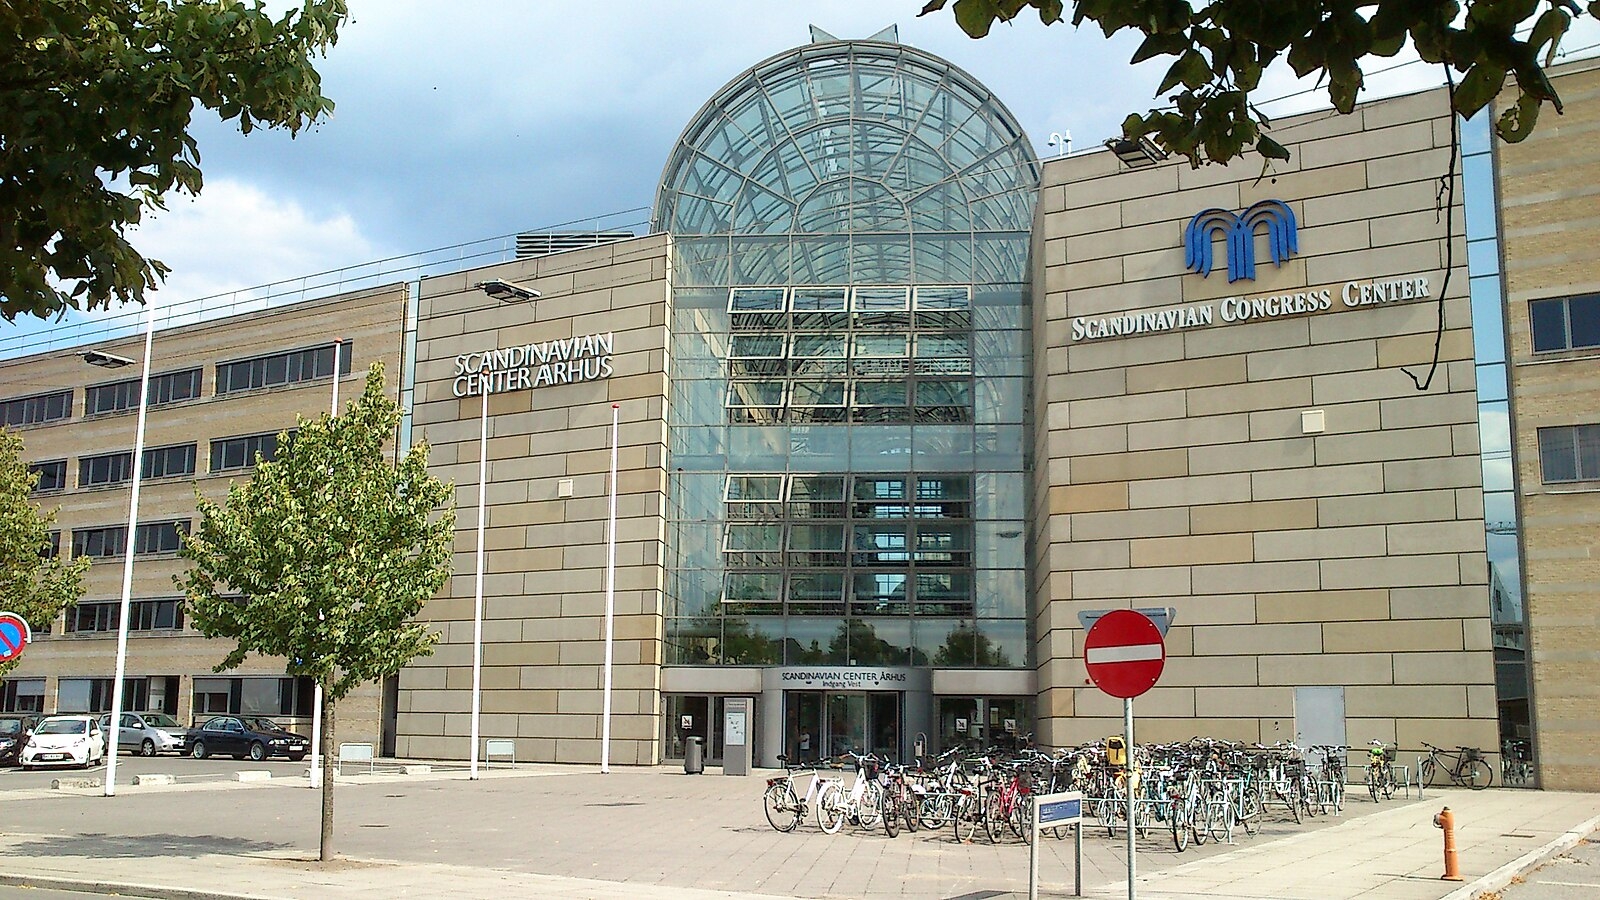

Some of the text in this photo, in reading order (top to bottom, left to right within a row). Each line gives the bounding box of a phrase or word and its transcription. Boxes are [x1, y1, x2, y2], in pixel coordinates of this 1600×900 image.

[1071, 276, 1431, 341] SCANDINAVIAN CONGRESS CENTER
[454, 332, 614, 376] SCANDINAVIAN
[452, 368, 532, 398] CENTER
[782, 671, 906, 682] SCANDINAVIAN CENTER ÅRHUS
[822, 680, 846, 688] Indgang
